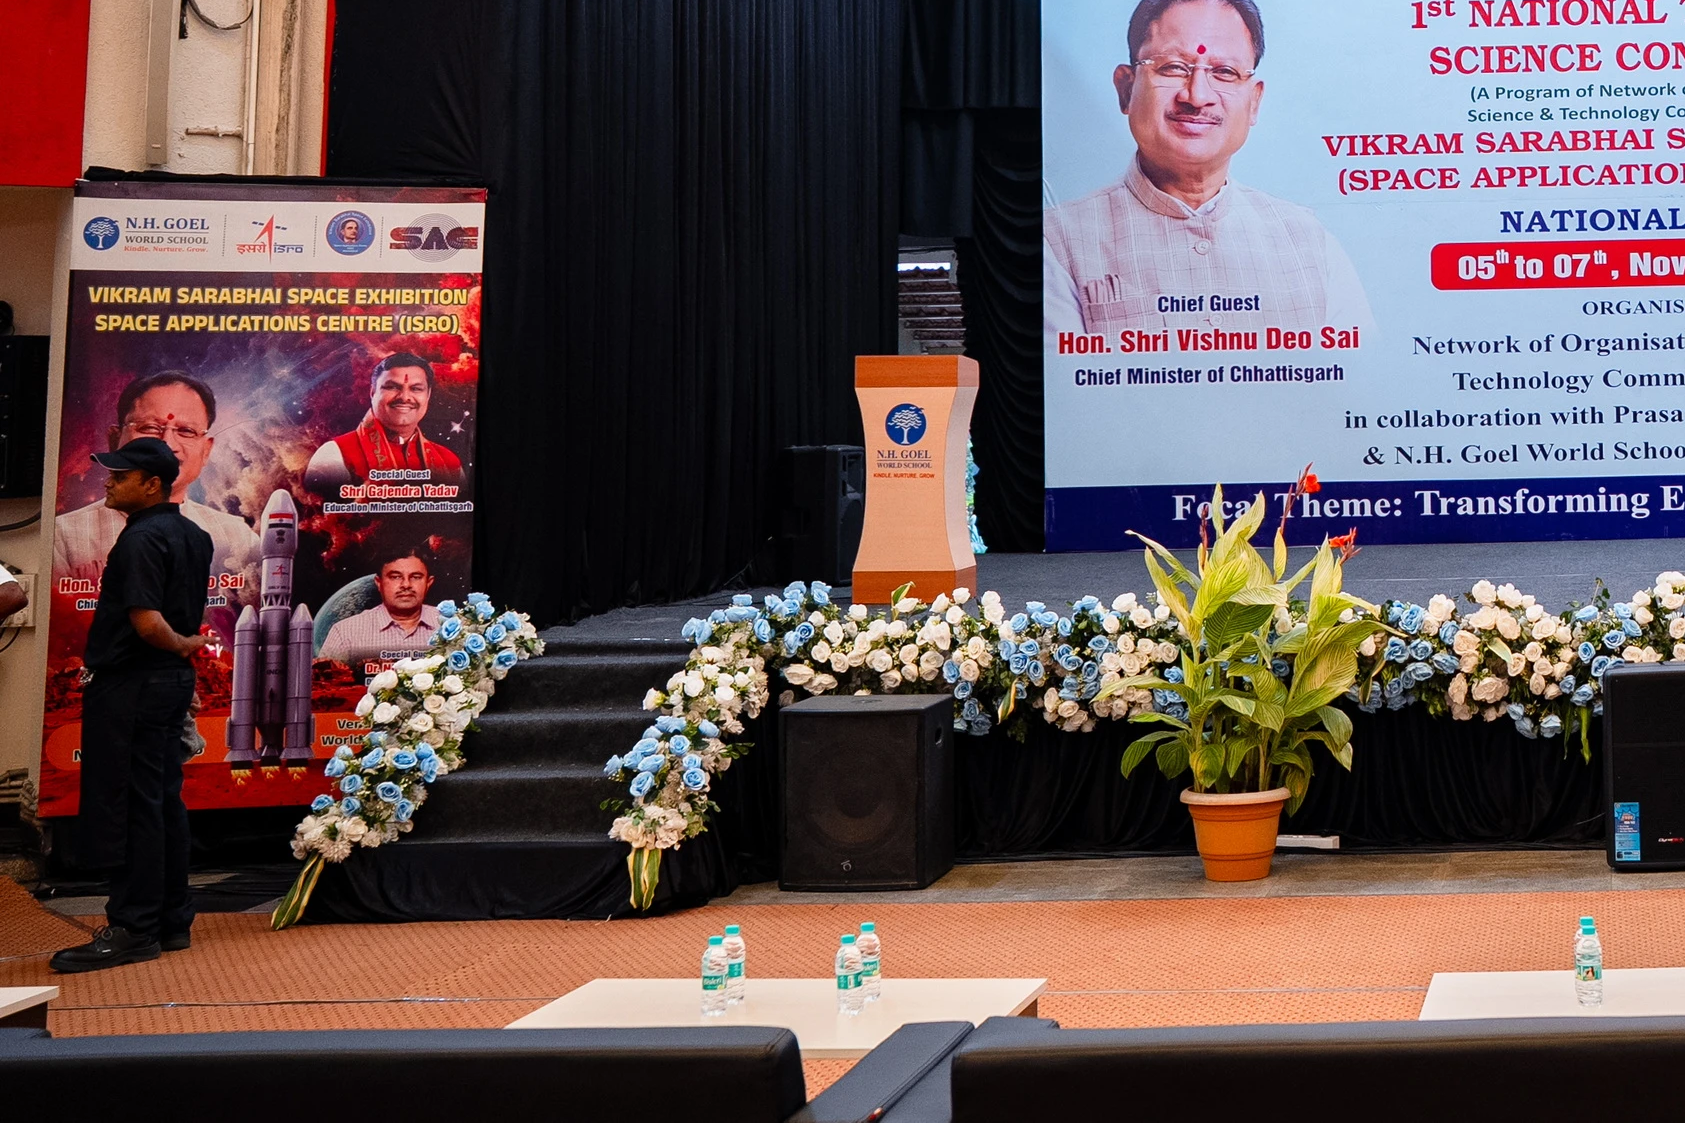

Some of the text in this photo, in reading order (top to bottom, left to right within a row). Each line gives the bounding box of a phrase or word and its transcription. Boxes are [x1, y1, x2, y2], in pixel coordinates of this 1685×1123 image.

[1430, 44, 1602, 75] SCIENCE
[1471, 87, 1489, 102] (A
[1496, 87, 1569, 101] Program
[1576, 84, 1594, 97] of
[1600, 83, 1676, 97] Network
[1468, 109, 1533, 122] Science
[1540, 108, 1553, 120] &
[1559, 106, 1659, 121] Technology
[1322, 133, 1463, 156] VIKRAM
[1476, 129, 1654, 153] SARABHAI
[1339, 168, 1460, 195] (SPACE
[125, 218, 209, 230] N.H. GOEL
[1459, 251, 1508, 281] 05th
[1515, 256, 1543, 278] to
[89, 287, 468, 305] VIKRAM SARABHAI SPACE EXHIBITION
[1158, 295, 1259, 312] Chief Guest
[95, 315, 459, 334] SPACE APPLICATIONS CENTRE (ISRO)
[1059, 327, 1358, 354] Hon. Shri Vishnu Deo Sai
[1413, 336, 1520, 354] Network
[1530, 334, 1554, 352] of
[1076, 365, 1343, 385] Chief Minister of Chhattisgarh
[1453, 372, 1593, 393] Technology
[1346, 411, 1367, 428] in
[1377, 408, 1540, 428] collaboration
[1551, 407, 1603, 424] with
[878, 450, 931, 458] N.H. GOEL
[1363, 447, 1384, 464] &
[1396, 446, 1451, 464] N.H.
[1461, 445, 1517, 463] Goel
[1527, 443, 1604, 461] World
[340, 485, 458, 499] Shri Gajendra Yadav
[1172, 492, 1262, 520] Foca
[1274, 490, 1402, 518] Theme:
[1415, 487, 1650, 518] Transforming
